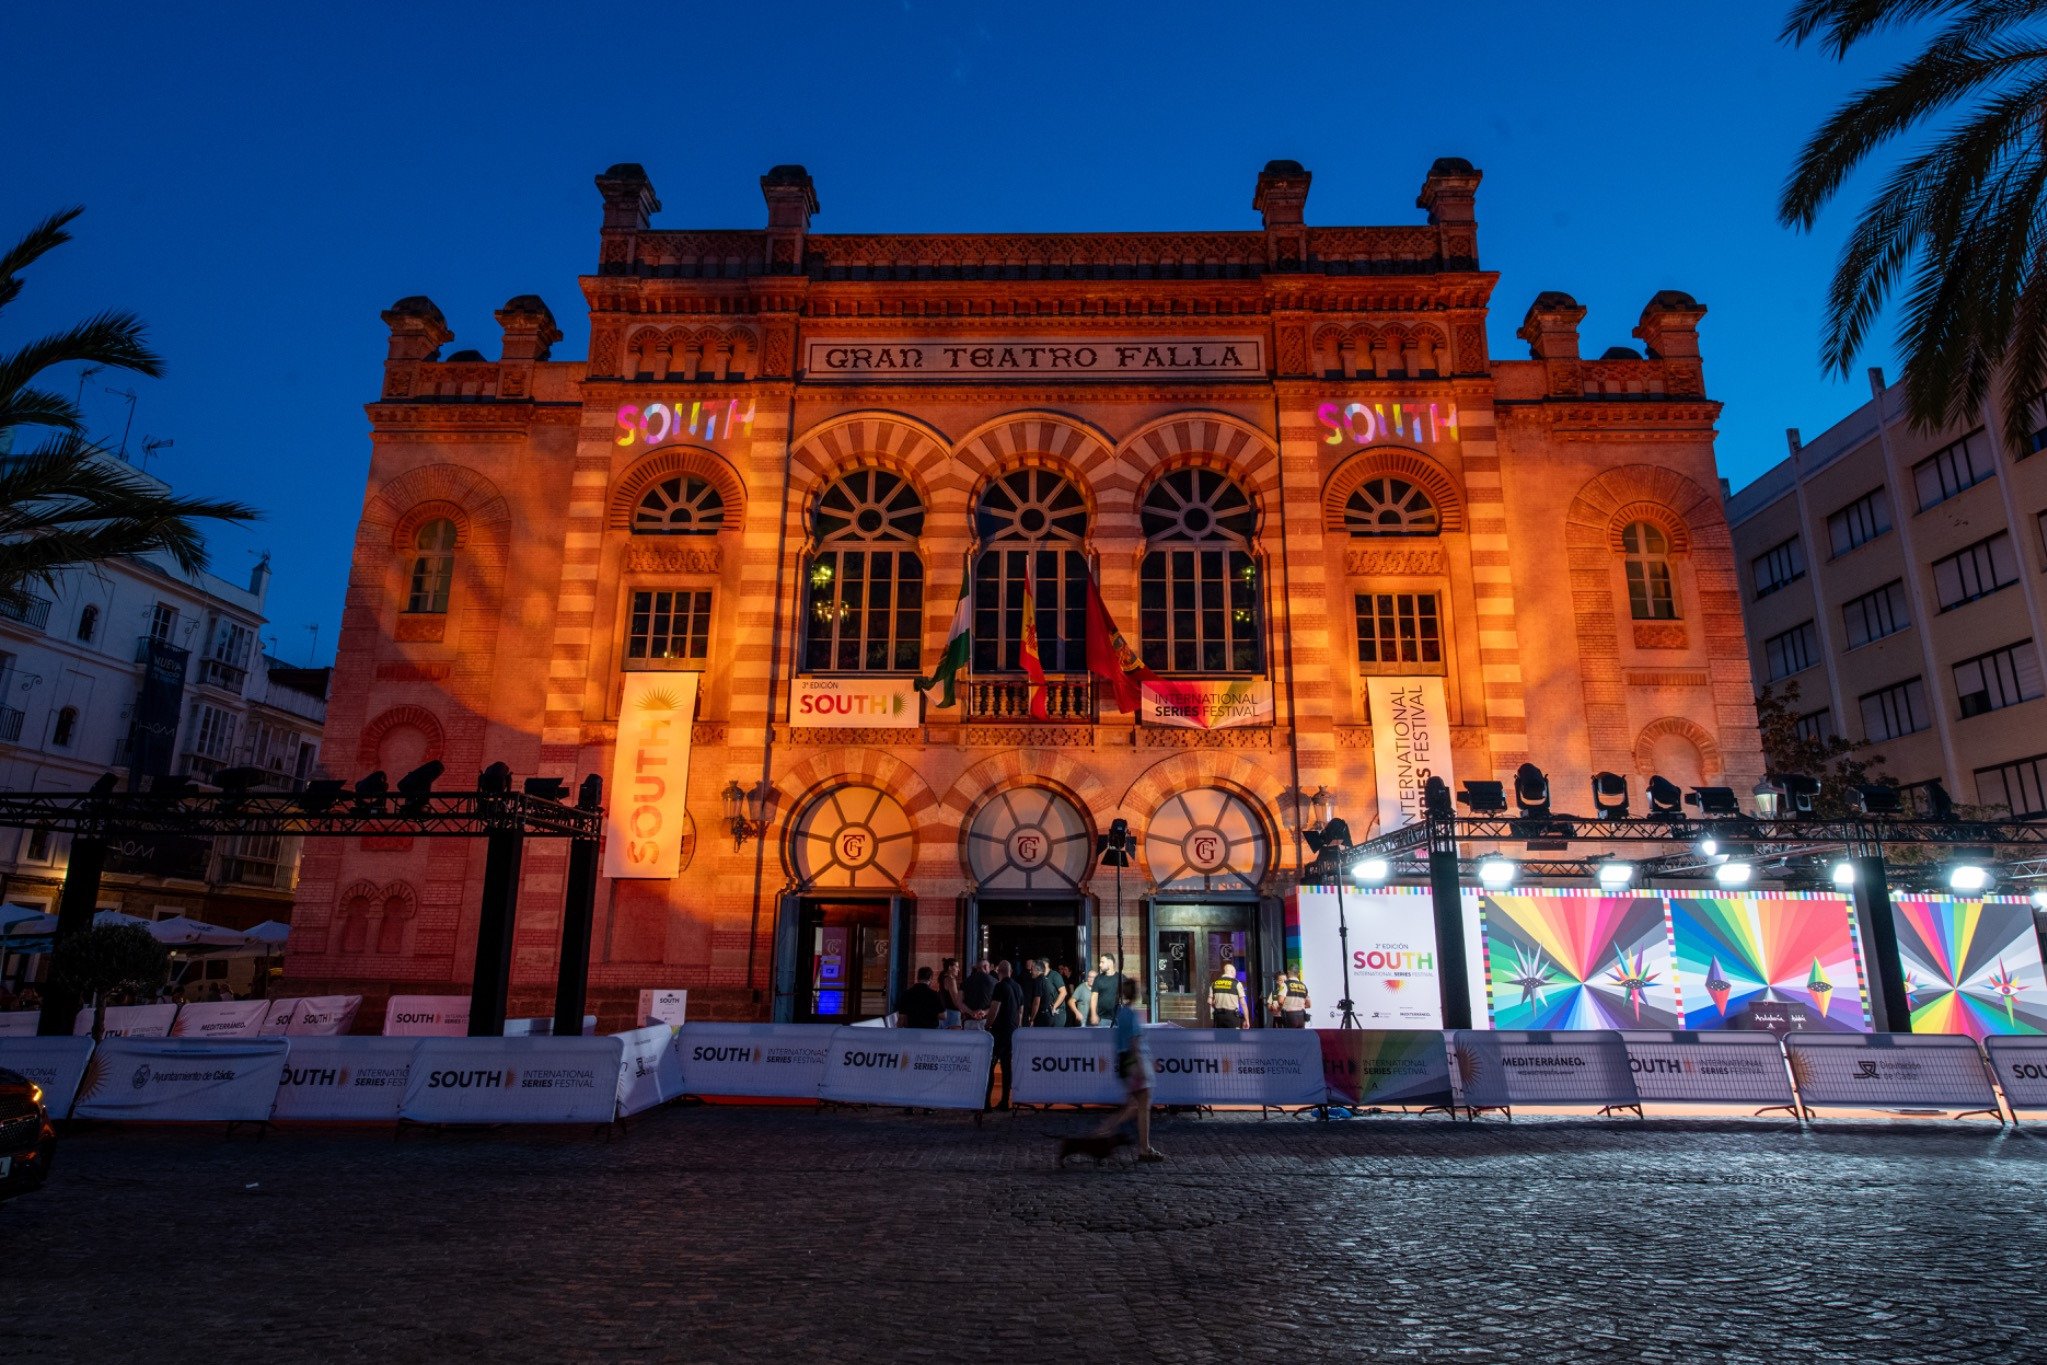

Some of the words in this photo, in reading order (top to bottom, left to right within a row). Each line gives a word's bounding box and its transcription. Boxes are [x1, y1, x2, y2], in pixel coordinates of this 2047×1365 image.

[824, 346, 924, 370] GRAN
[943, 346, 1099, 369] TEATRO
[1115, 345, 1244, 368] FALLA
[615, 399, 756, 446] SOUTH
[1317, 402, 1459, 445] SOUTH
[810, 681, 839, 690] EDICIÓN
[799, 694, 888, 715] SOUTH
[1155, 693, 1259, 705] INTERNATIONAL
[1155, 705, 1199, 717] SERIES
[1202, 705, 1260, 717] FESTIVAL
[1408, 685, 1431, 762] FESTIVAL
[626, 719, 672, 865] SOUTH
[1353, 951, 1433, 969] SOUTH
[303, 1014, 327, 1024] SOUTH
[396, 1013, 434, 1024] SOUTH
[692, 1046, 751, 1062] SOUTH
[767, 1048, 826, 1056] INTERNATIONAL
[766, 1056, 792, 1064] SERIES
[793, 1056, 825, 1064] FESTIVAL
[843, 1051, 899, 1069] SOUTH
[914, 1054, 972, 1064] INTERNATIONAL
[1031, 1056, 1095, 1073] SOUTH
[1237, 1058, 1301, 1067] INTERNATIONAL
[1362, 1059, 1427, 1067] INTERNATIONAL
[1502, 1055, 1586, 1067] MEDITERRÁNEO.
[1700, 1059, 1764, 1067] INTERNATIONAL
[913, 1063, 939, 1071] SERIES
[939, 1063, 972, 1073] FESTIVAL
[1154, 1058, 1219, 1074] SOUTH
[1237, 1067, 1266, 1075] SERIES
[1267, 1067, 1303, 1075] FESTIVAL
[1701, 1067, 1729, 1075] SERIES
[1730, 1067, 1766, 1075] FESTIVAL
[151, 1071, 202, 1083] Ayuntamiento
[202, 1071, 212, 1081] de
[213, 1069, 236, 1081] Cádiz
[428, 1071, 502, 1088] SOUTH
[523, 1070, 595, 1079] INTERNATIONAL
[355, 1078, 385, 1086] SERIES
[521, 1079, 553, 1088] SERIES
[554, 1079, 596, 1088] FESTIVAL
